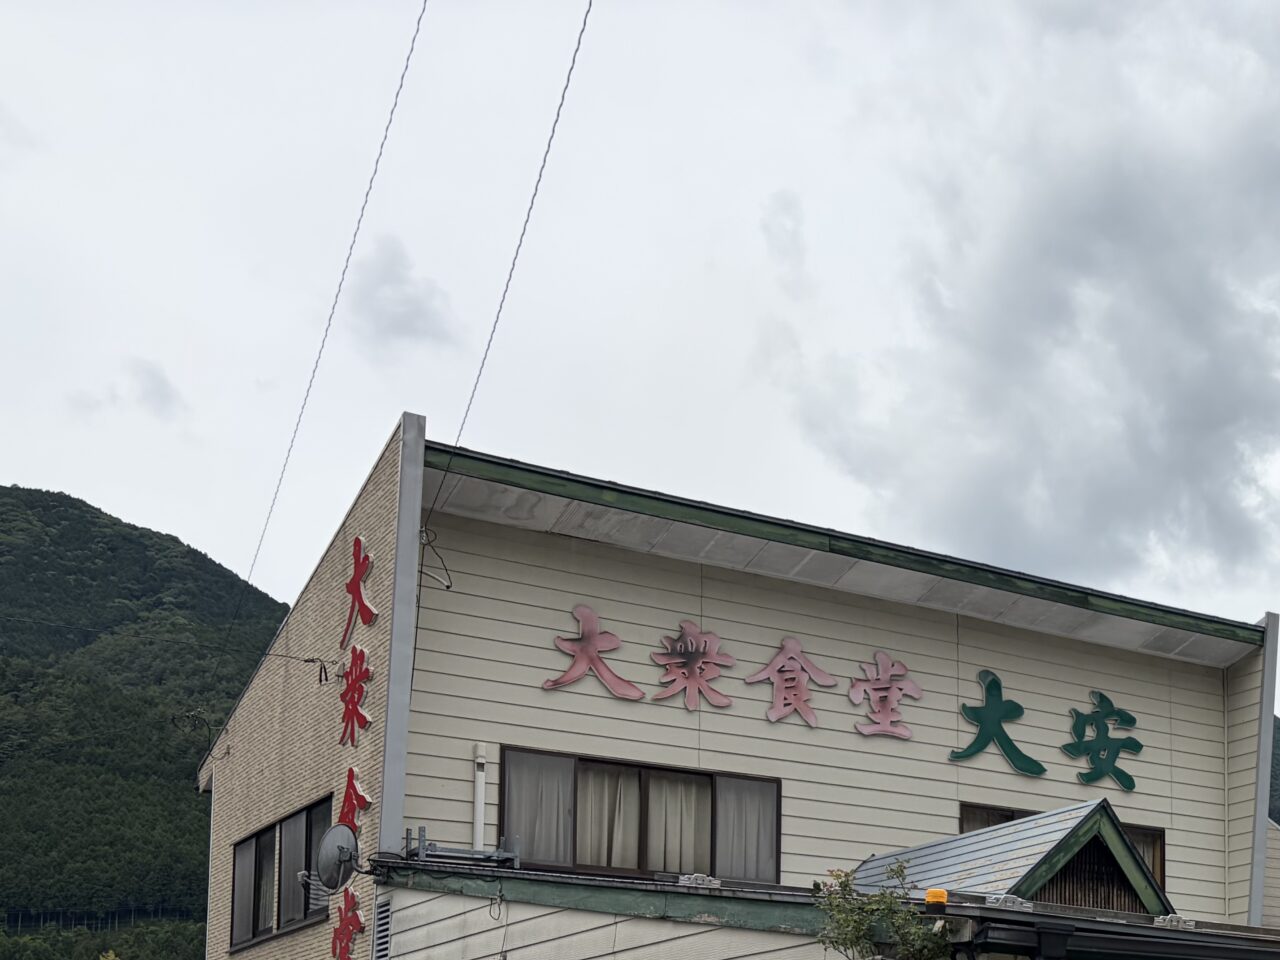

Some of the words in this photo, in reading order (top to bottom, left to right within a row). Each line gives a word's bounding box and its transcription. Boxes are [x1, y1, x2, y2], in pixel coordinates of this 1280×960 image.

[542, 604, 923, 740] 大衆食堂
[948, 668, 1144, 791] 大安
